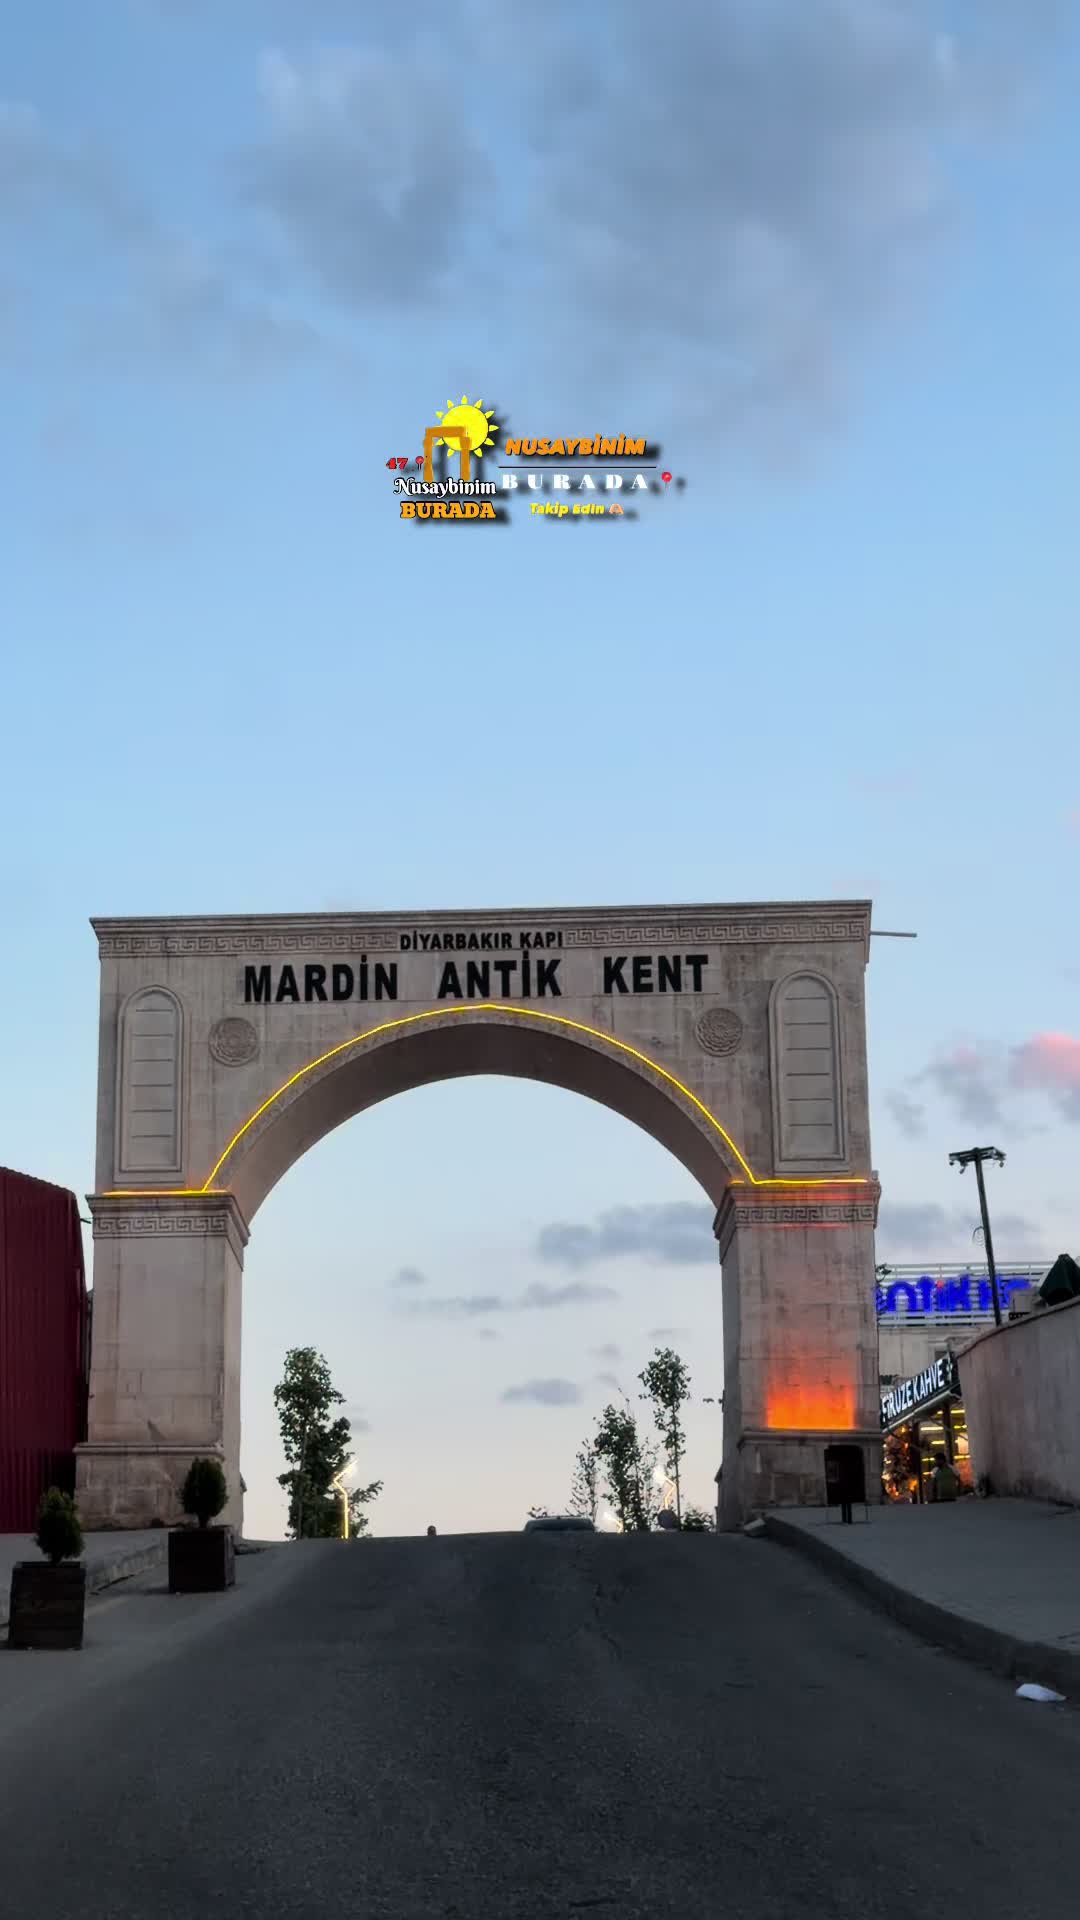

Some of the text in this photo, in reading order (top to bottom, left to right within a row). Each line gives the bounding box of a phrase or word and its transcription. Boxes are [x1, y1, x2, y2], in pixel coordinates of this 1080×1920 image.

[400, 930, 562, 951] DİYARBAKIR KAPI
[244, 950, 709, 1002] MARDİN ANTİK KENT
[912, 1358, 945, 1403] KAHVE
